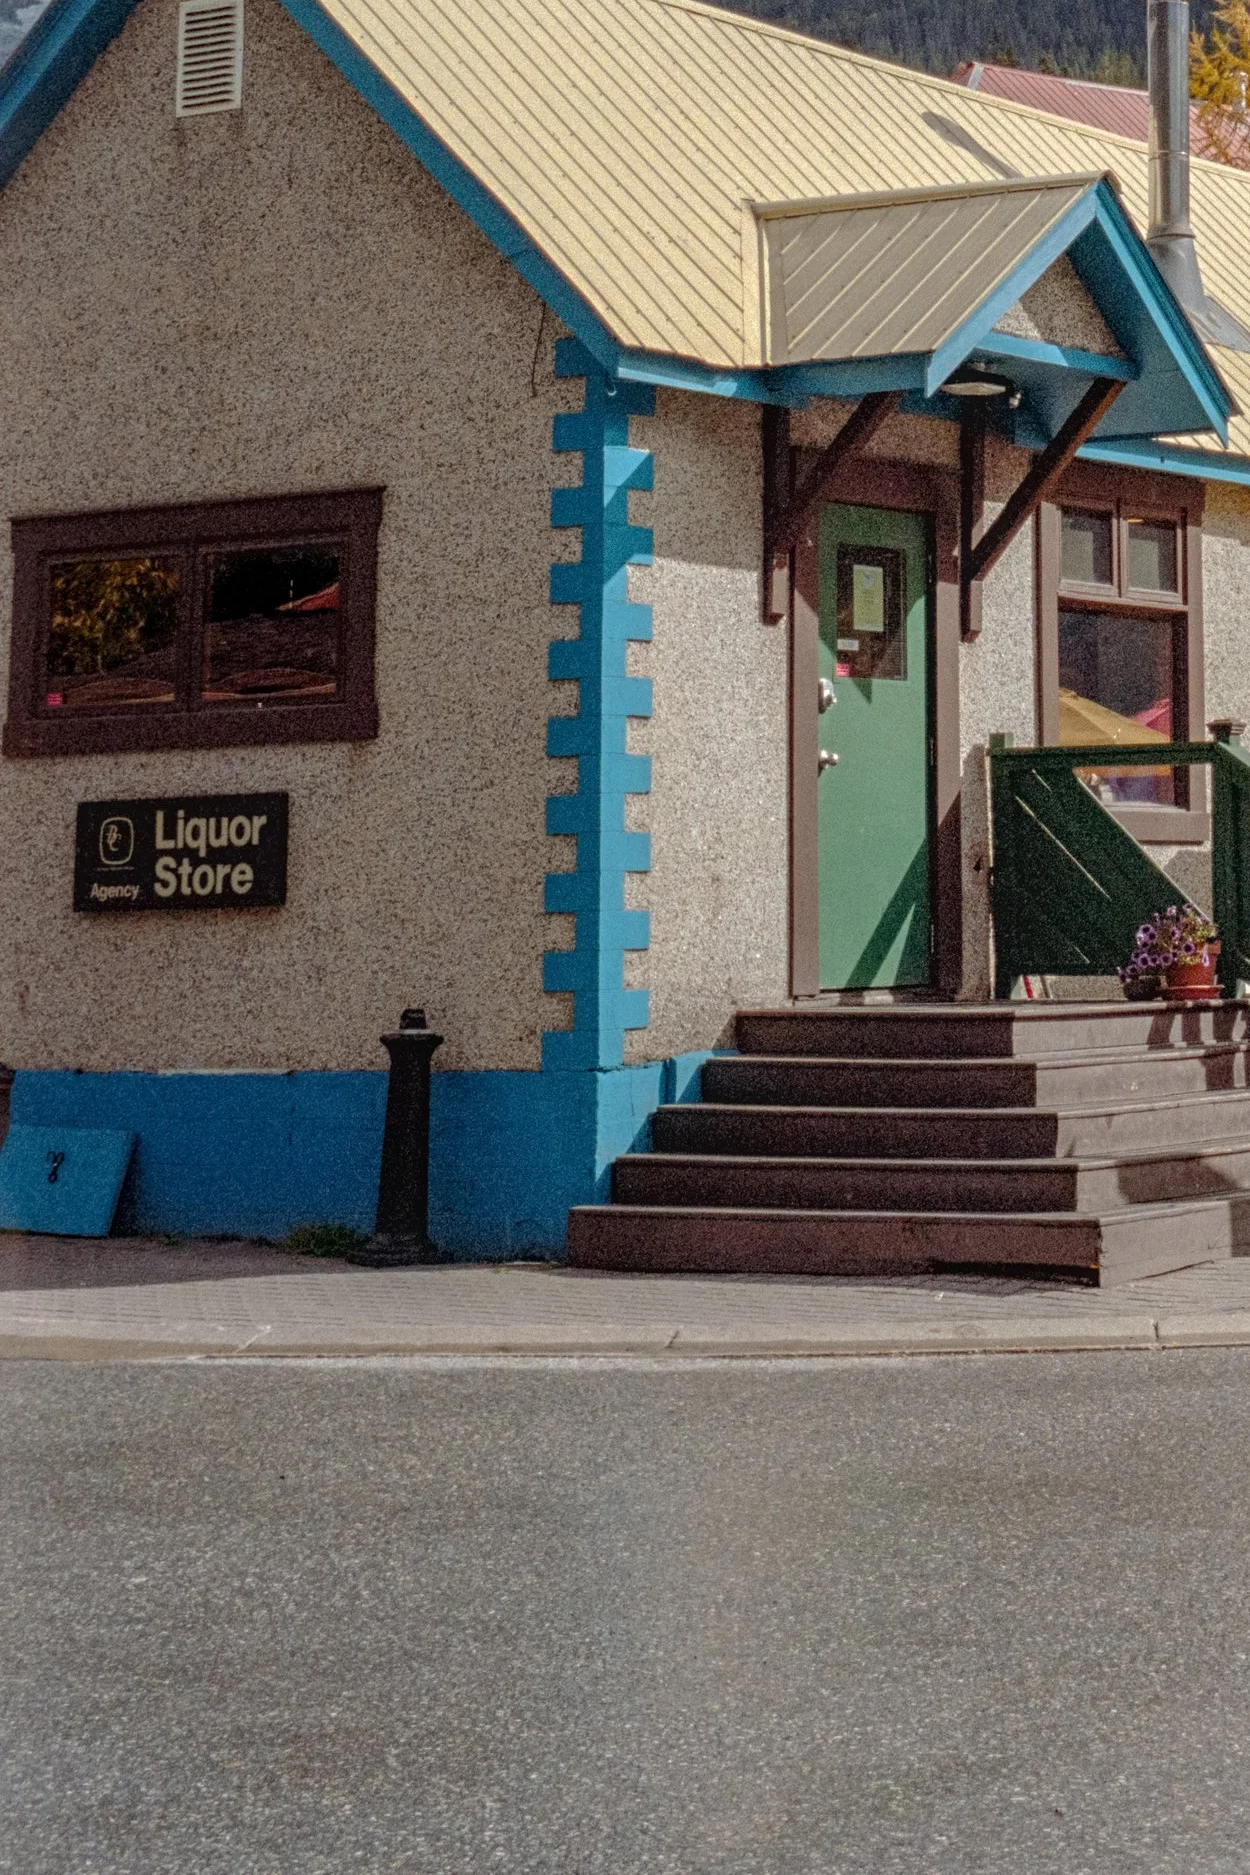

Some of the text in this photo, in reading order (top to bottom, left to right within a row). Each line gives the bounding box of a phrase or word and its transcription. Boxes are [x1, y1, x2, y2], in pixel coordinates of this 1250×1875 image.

[155, 809, 267, 857] Liquor
[89, 882, 140, 902] Agency
[153, 856, 254, 897] Store
